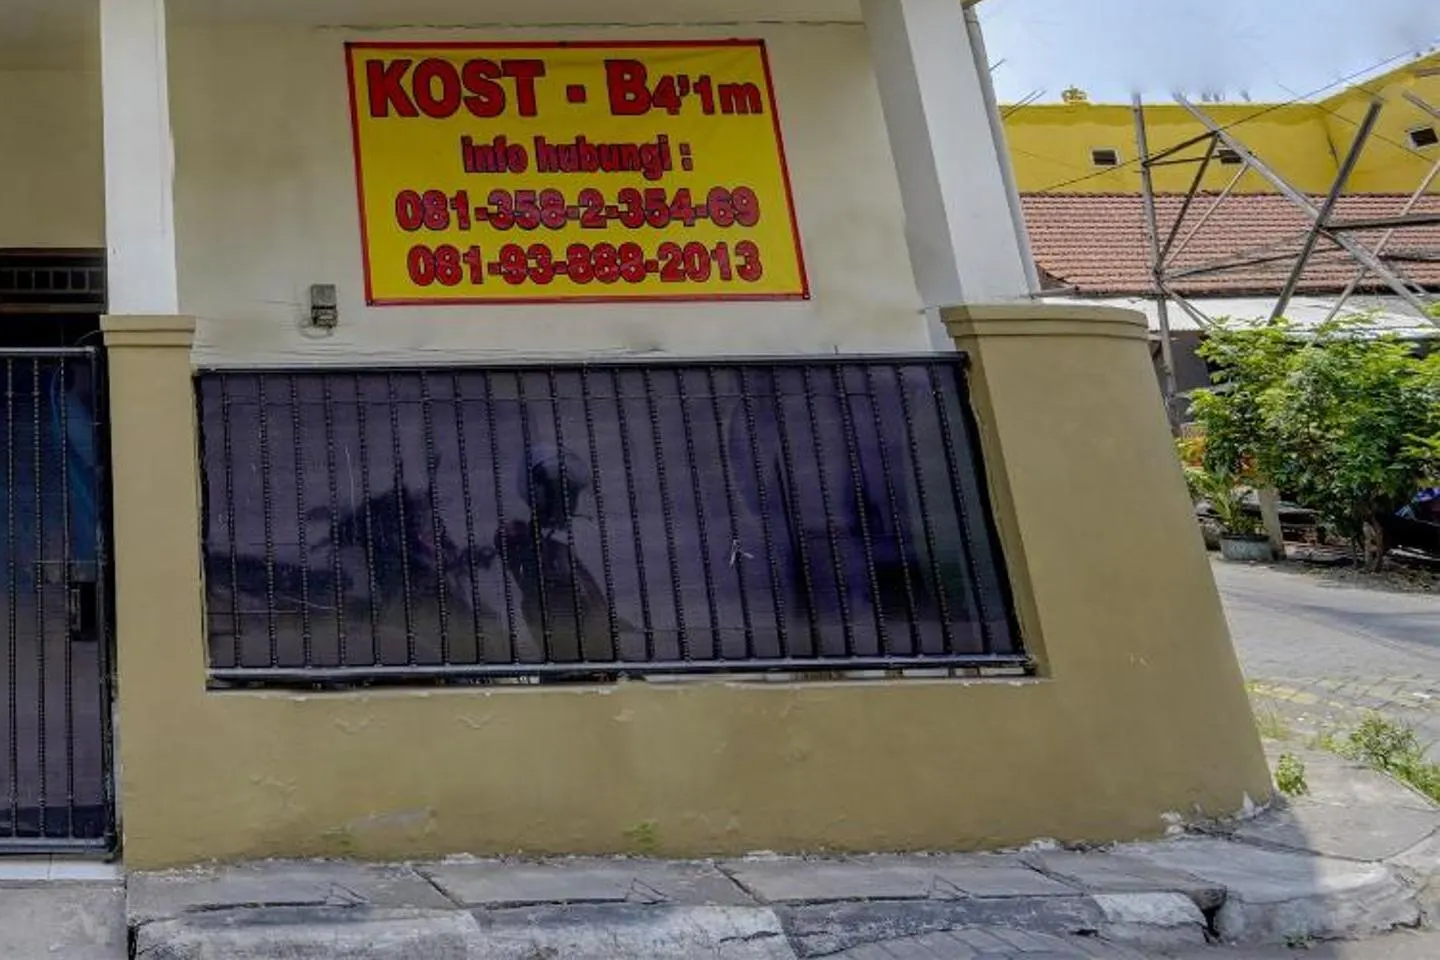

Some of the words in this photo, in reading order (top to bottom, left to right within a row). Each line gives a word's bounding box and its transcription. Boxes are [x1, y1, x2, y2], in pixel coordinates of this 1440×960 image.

[366, 59, 545, 118] KOST
[604, 59, 763, 115] B4'1m
[534, 135, 673, 181] hubungi
[395, 187, 759, 231] 081-358-2-354-69
[407, 240, 763, 287] 081-93-888-2013
